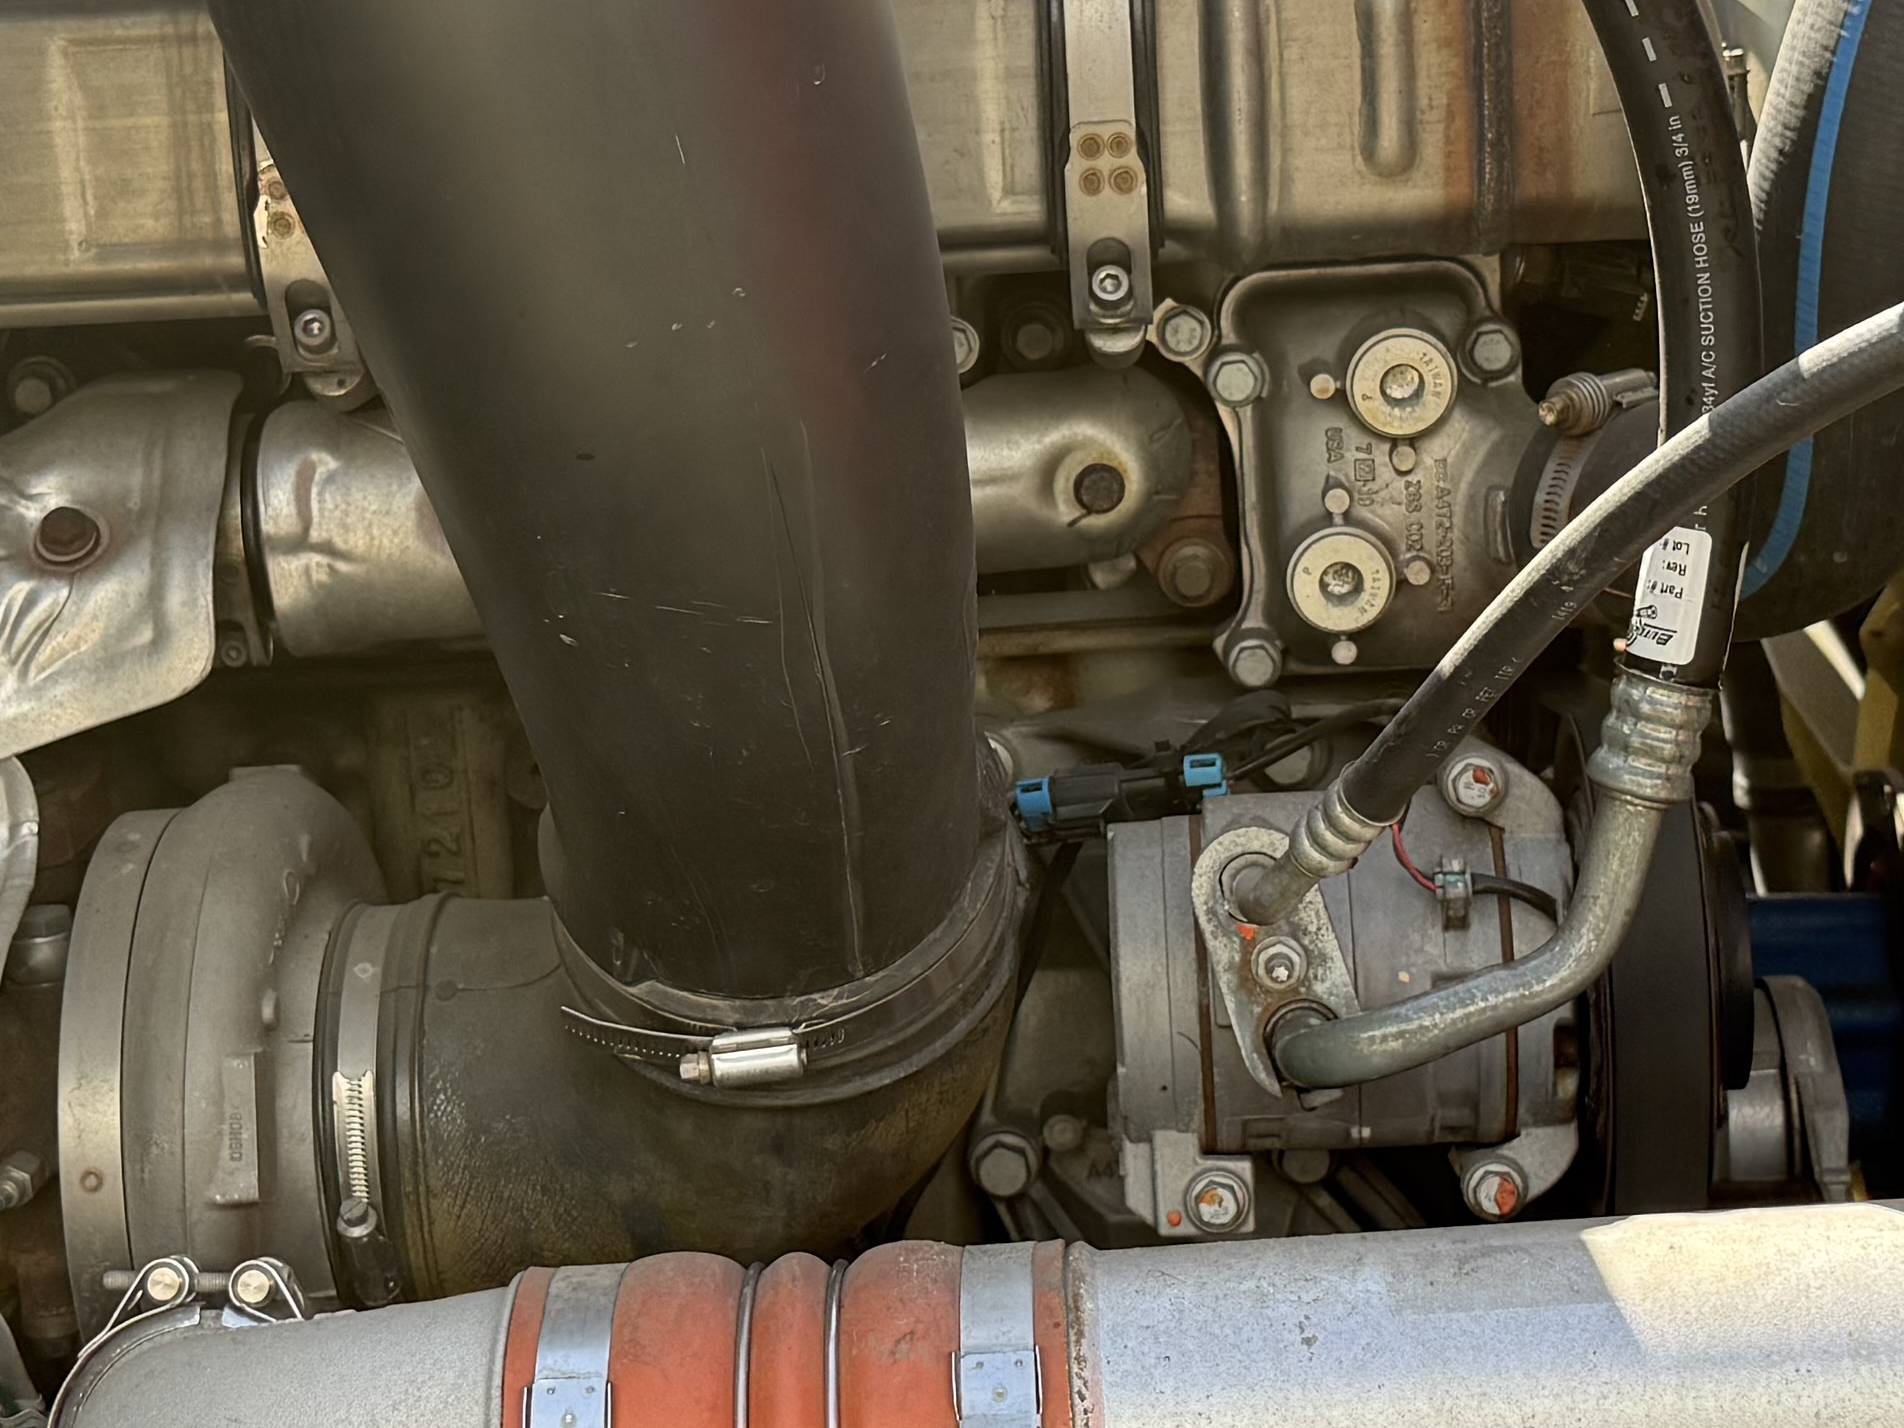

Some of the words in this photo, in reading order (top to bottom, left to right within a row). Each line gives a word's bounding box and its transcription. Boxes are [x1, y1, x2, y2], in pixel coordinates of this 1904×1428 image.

[1668, 115, 1682, 131] in
[1671, 133, 1689, 157] 3/4
[1678, 160, 1704, 217] (19mm)
[1690, 221, 1709, 268] HOSE
[1696, 272, 1715, 347] SUCTION
[1701, 350, 1716, 379] A/C
[1325, 427, 1344, 464] USA
[1672, 539, 1690, 555] Lot
[1662, 559, 1687, 576] Rev:
[1660, 581, 1684, 599] Part
